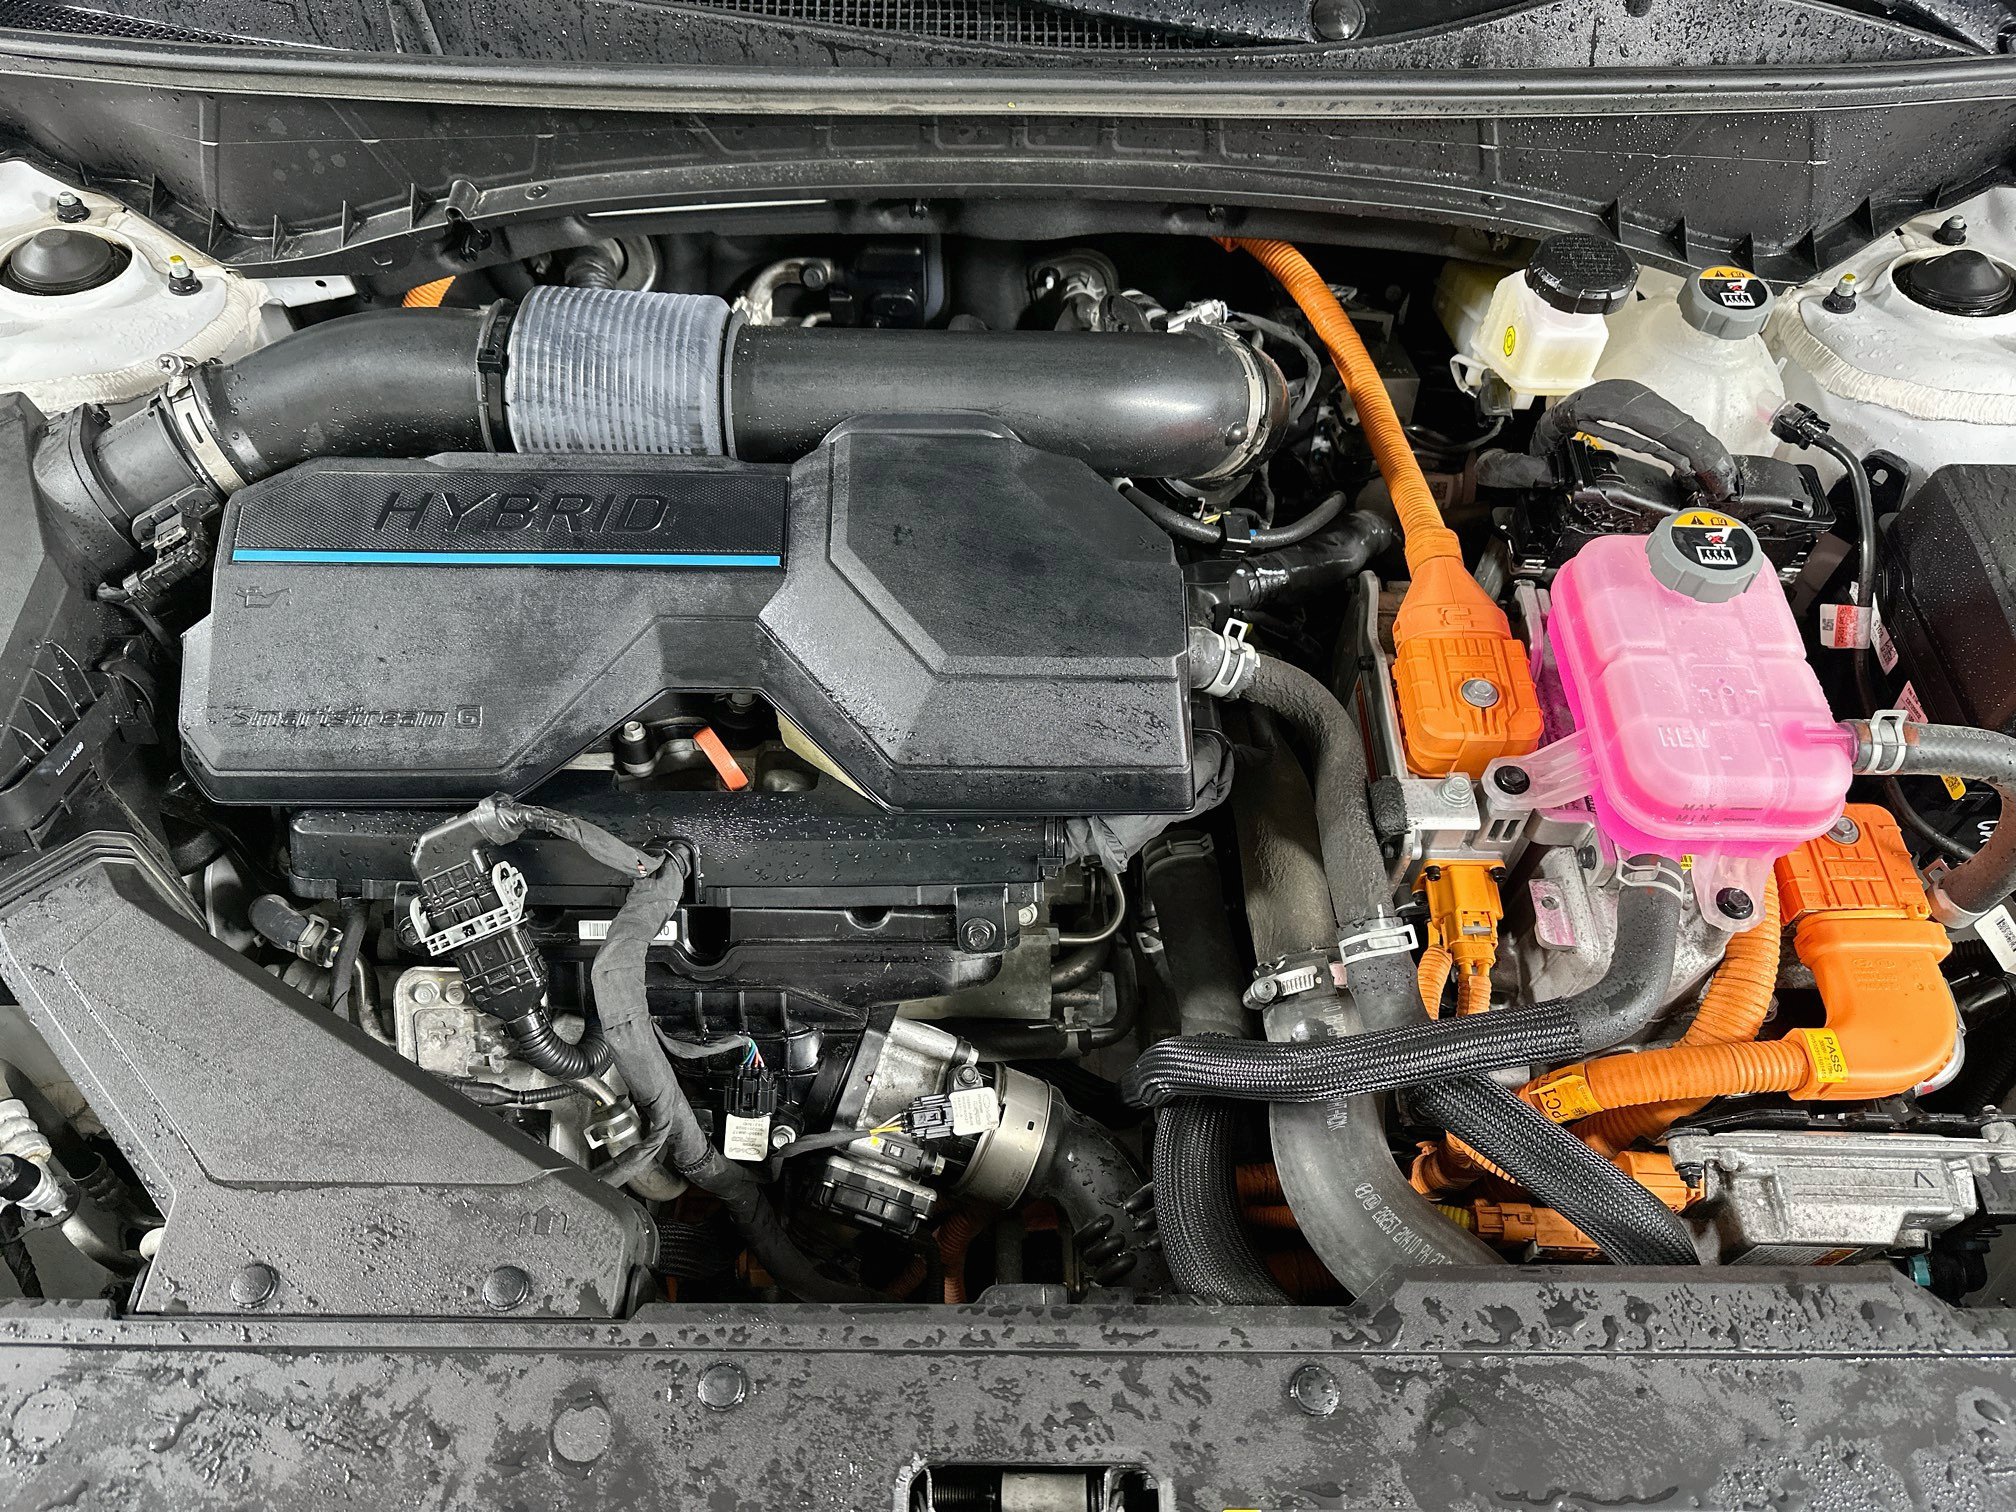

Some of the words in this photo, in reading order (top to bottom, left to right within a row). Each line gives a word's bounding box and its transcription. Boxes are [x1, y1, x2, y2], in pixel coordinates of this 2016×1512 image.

[372, 492, 670, 533] HYBRID
[229, 706, 449, 728] Smartstream
[457, 705, 482, 728] G
[1656, 724, 1711, 748] HEV
[1676, 814, 1709, 822] MIN
[1682, 803, 1717, 811] MAX
[1824, 1035, 1843, 1073] PASS
[1542, 1088, 1568, 1119] PC1
